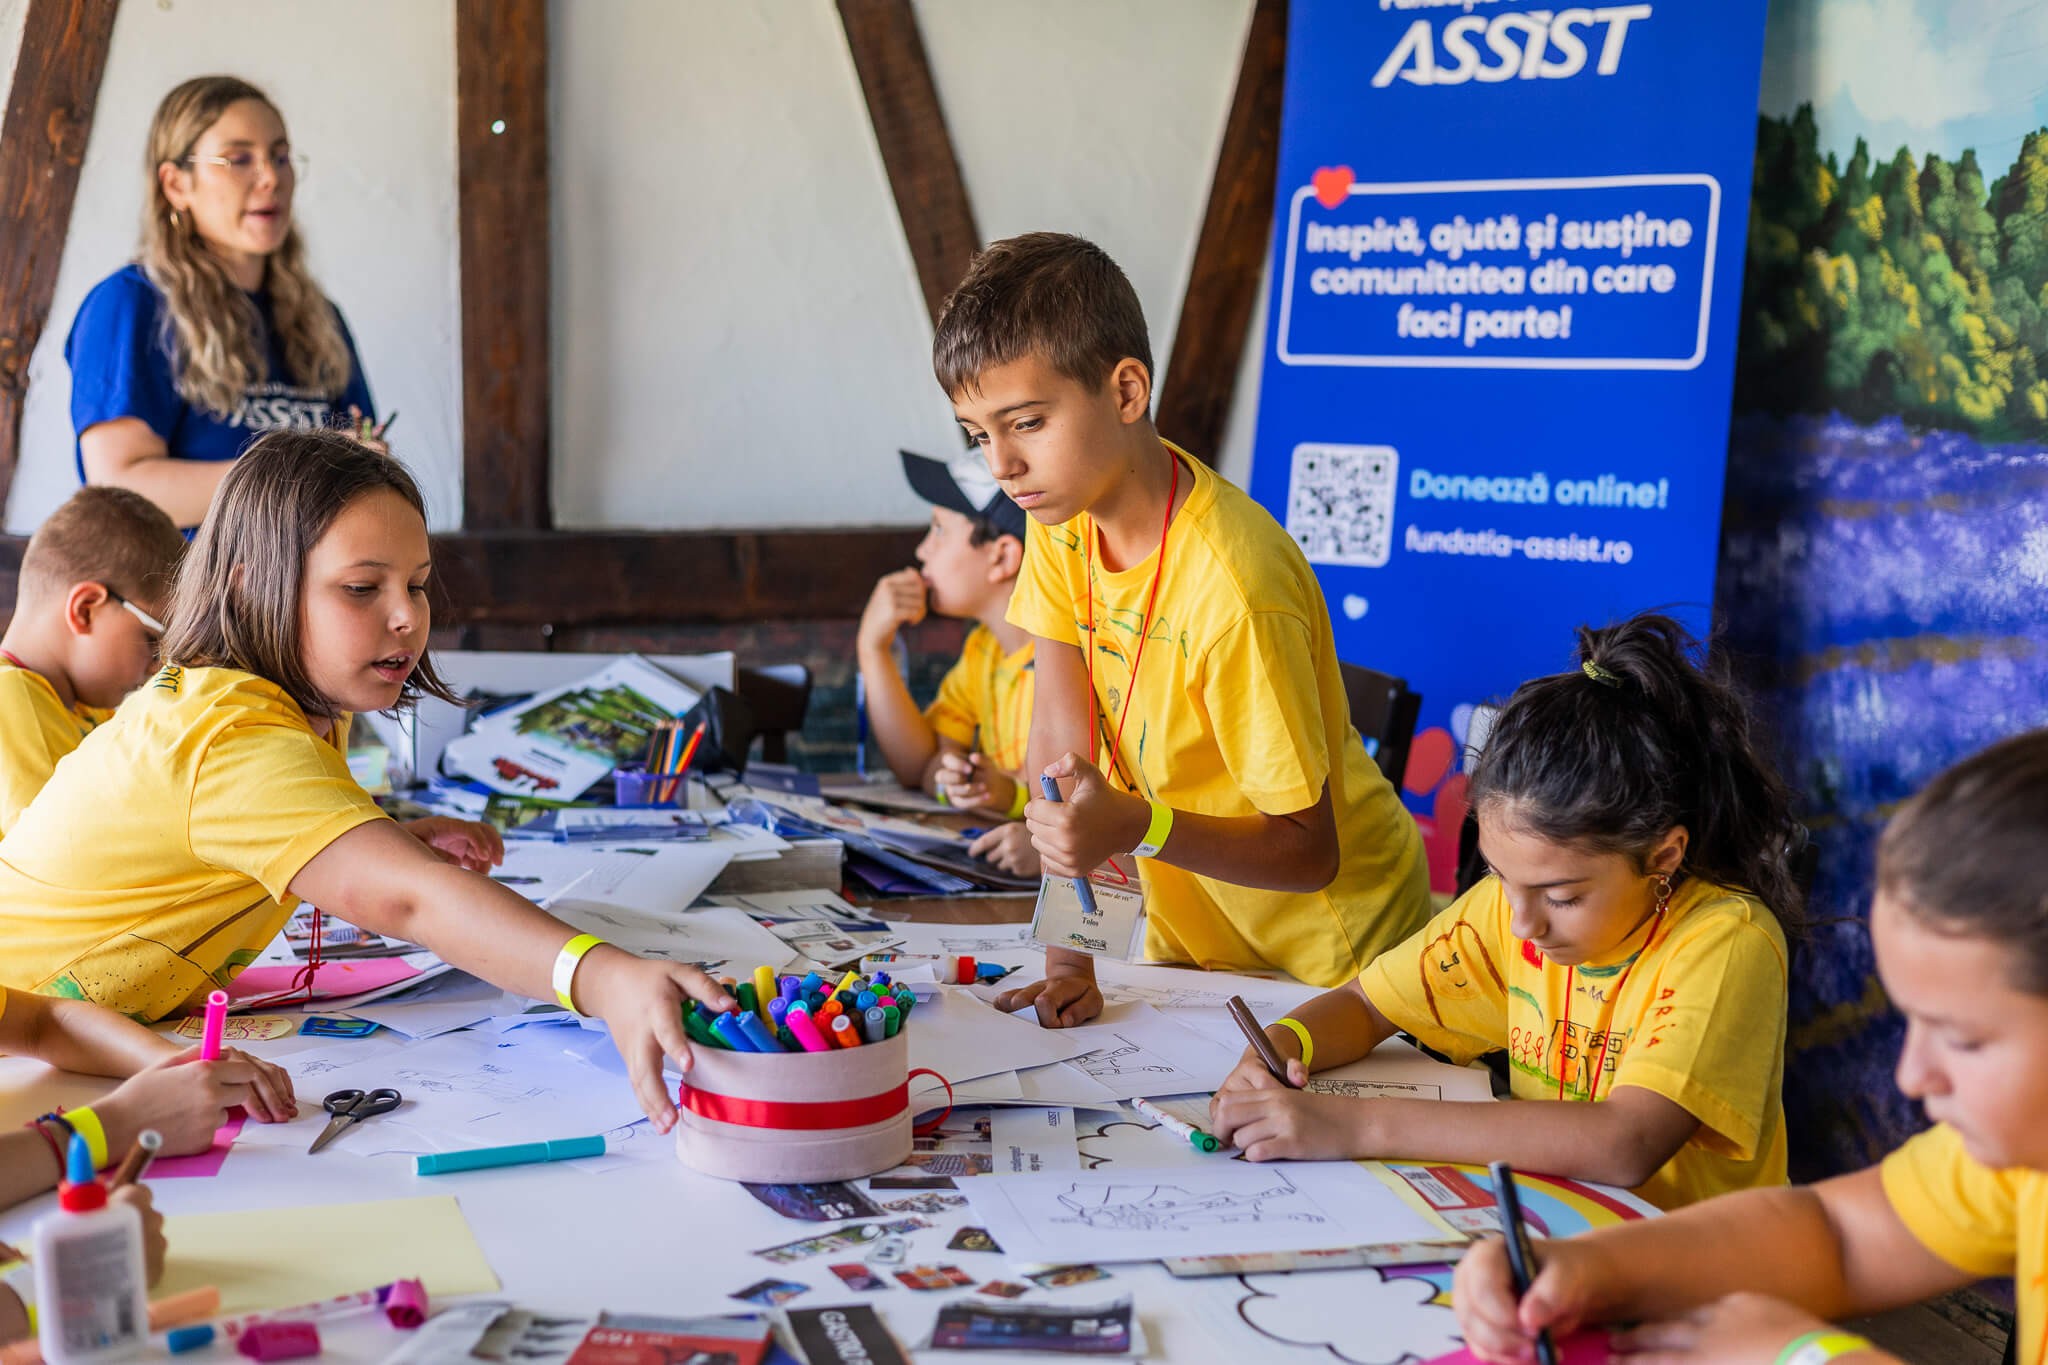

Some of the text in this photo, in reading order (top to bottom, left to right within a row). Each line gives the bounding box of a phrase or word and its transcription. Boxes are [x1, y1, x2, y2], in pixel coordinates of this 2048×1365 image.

[1371, 4, 1653, 88] ASSIST
[1306, 212, 1693, 260] Inspiră, ajută și susține
[1310, 259, 1677, 295] comunitatea din care
[1397, 303, 1572, 348] faci parte!
[1410, 470, 1669, 508] Donează online!
[1405, 526, 1634, 564] fundatia-assist.ro
